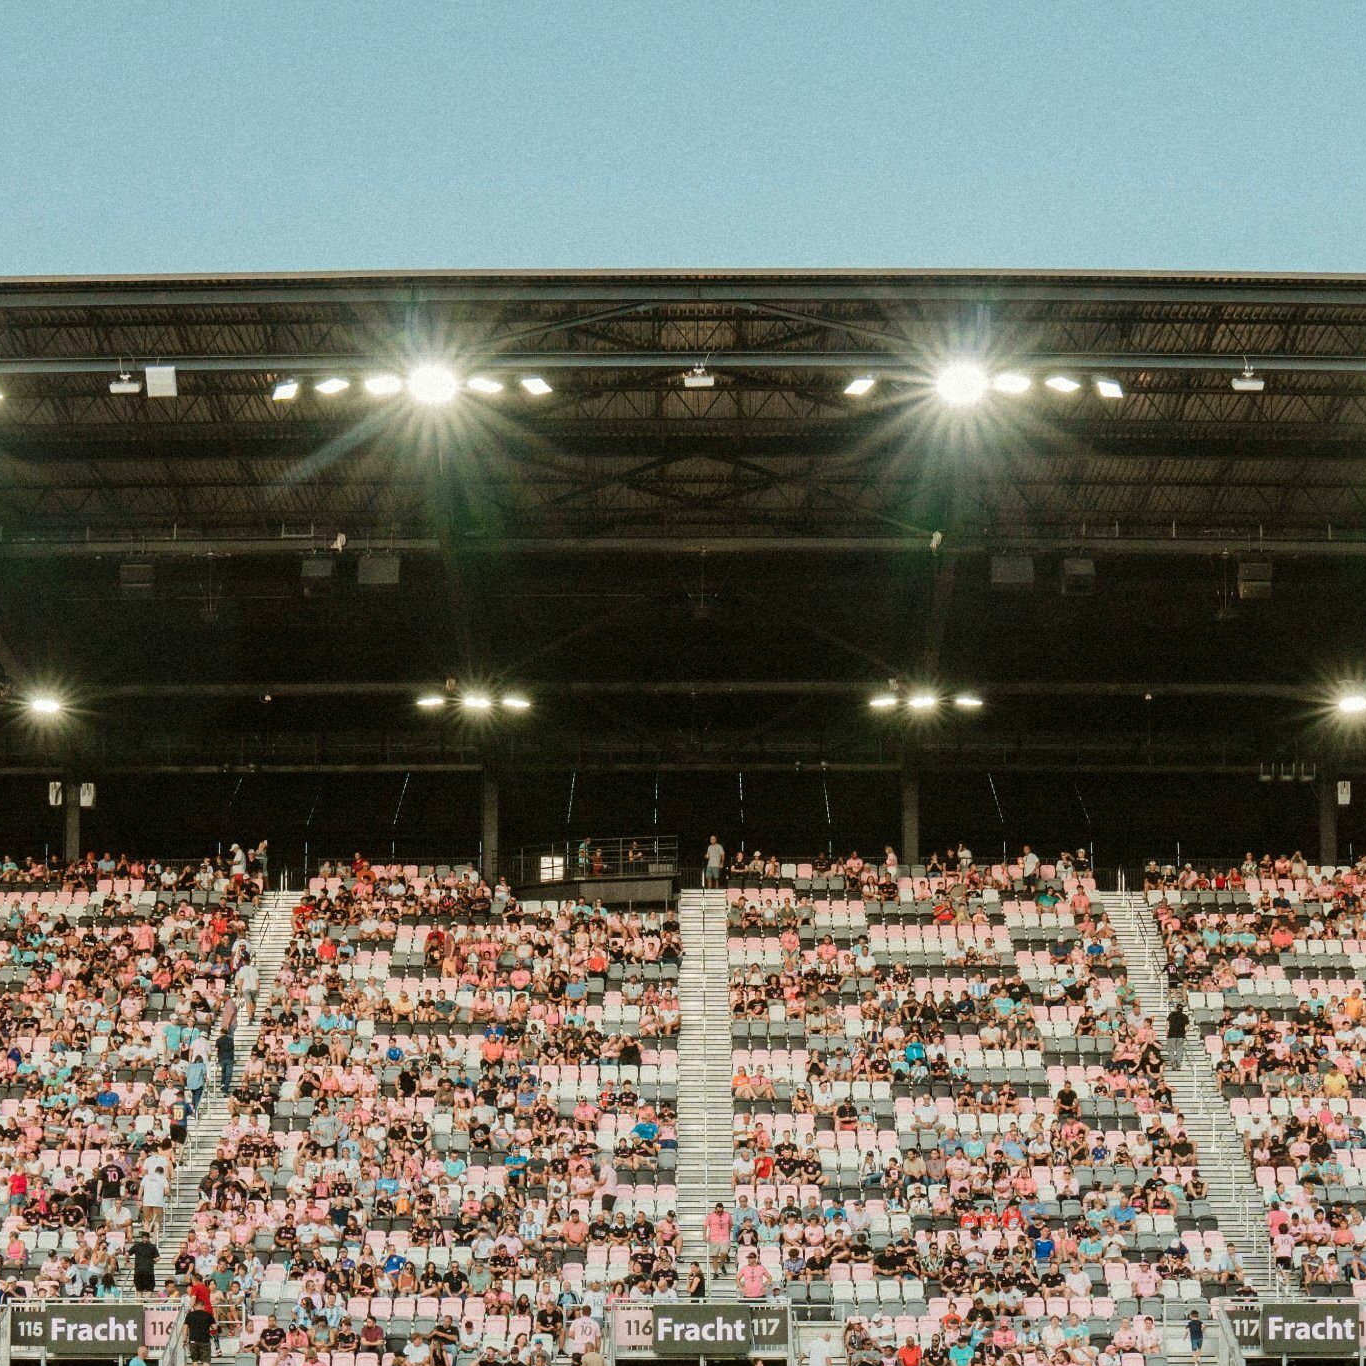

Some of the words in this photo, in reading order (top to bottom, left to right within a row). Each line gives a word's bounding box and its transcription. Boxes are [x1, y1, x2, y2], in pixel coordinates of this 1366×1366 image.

[173, 1108, 184, 1120] 10
[106, 1171, 118, 1182] 10
[18, 1321, 43, 1337] 115
[51, 1317, 138, 1341] Fracht
[580, 1325, 592, 1336] 10
[625, 1320, 652, 1336] 116
[658, 1317, 746, 1341] Fracht
[752, 1318, 780, 1336] 117
[1232, 1319, 1259, 1336] 117
[1268, 1315, 1356, 1340] Fracht
